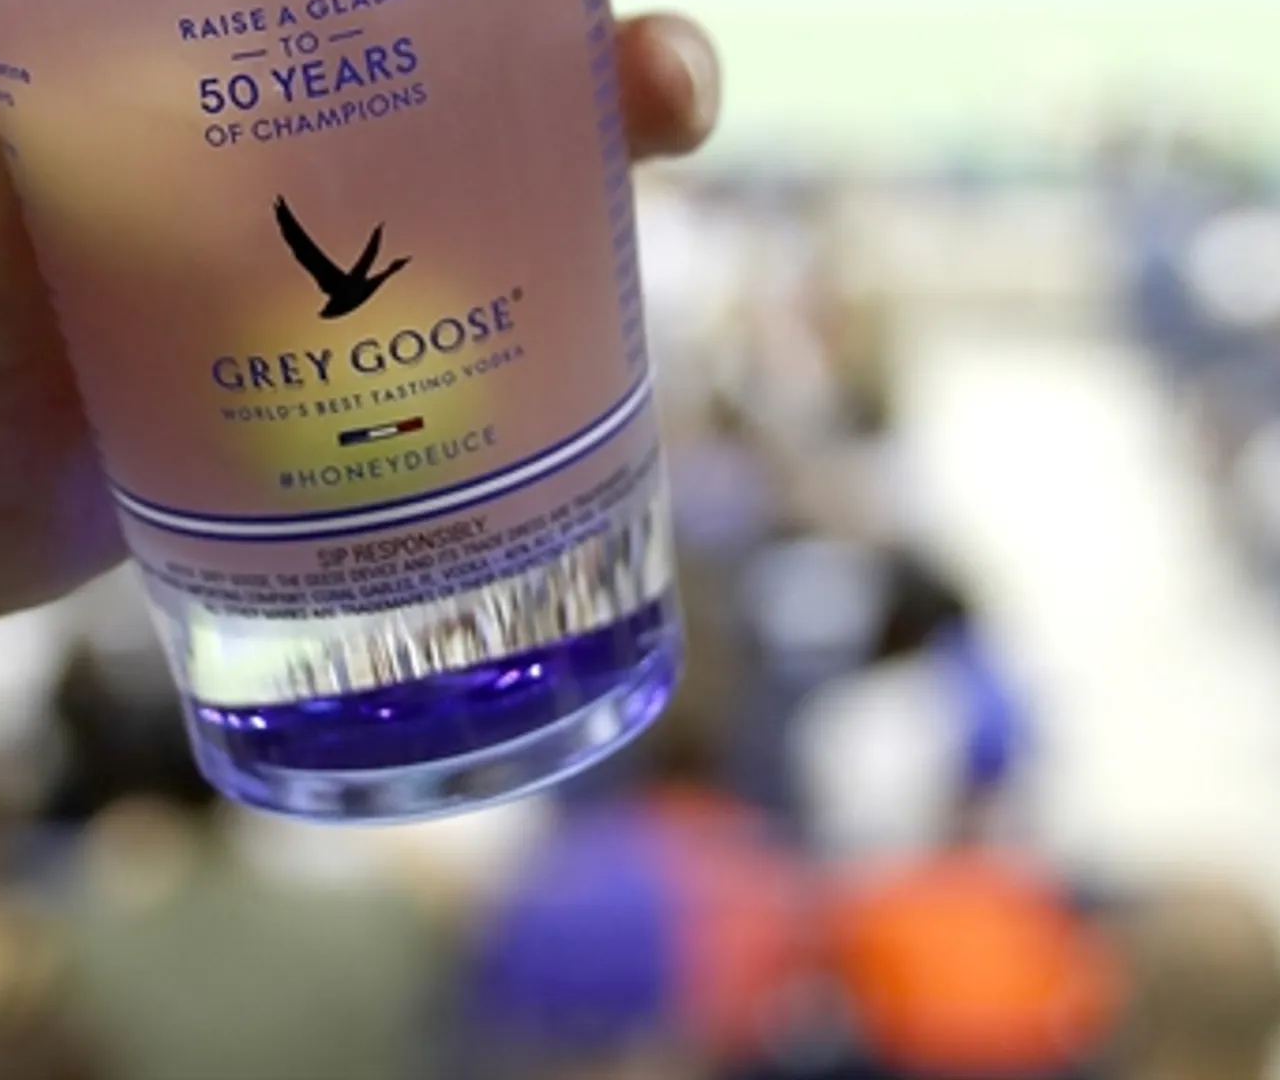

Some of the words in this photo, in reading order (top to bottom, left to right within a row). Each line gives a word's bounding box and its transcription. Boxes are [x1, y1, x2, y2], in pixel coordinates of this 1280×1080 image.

[178, 7, 267, 41] RAISE
[277, 6, 297, 27] A
[278, 30, 320, 58] TO
[199, 73, 260, 115] 50
[270, 36, 419, 103] YEARS
[204, 122, 245, 148] OF
[250, 82, 429, 143] CHAMPIONS
[211, 348, 333, 392] GREY
[315, 393, 363, 417] BEST
[369, 370, 458, 407] TASTING
[463, 344, 526, 378] VODKA
[279, 424, 498, 489] #HONEYDEUCE
